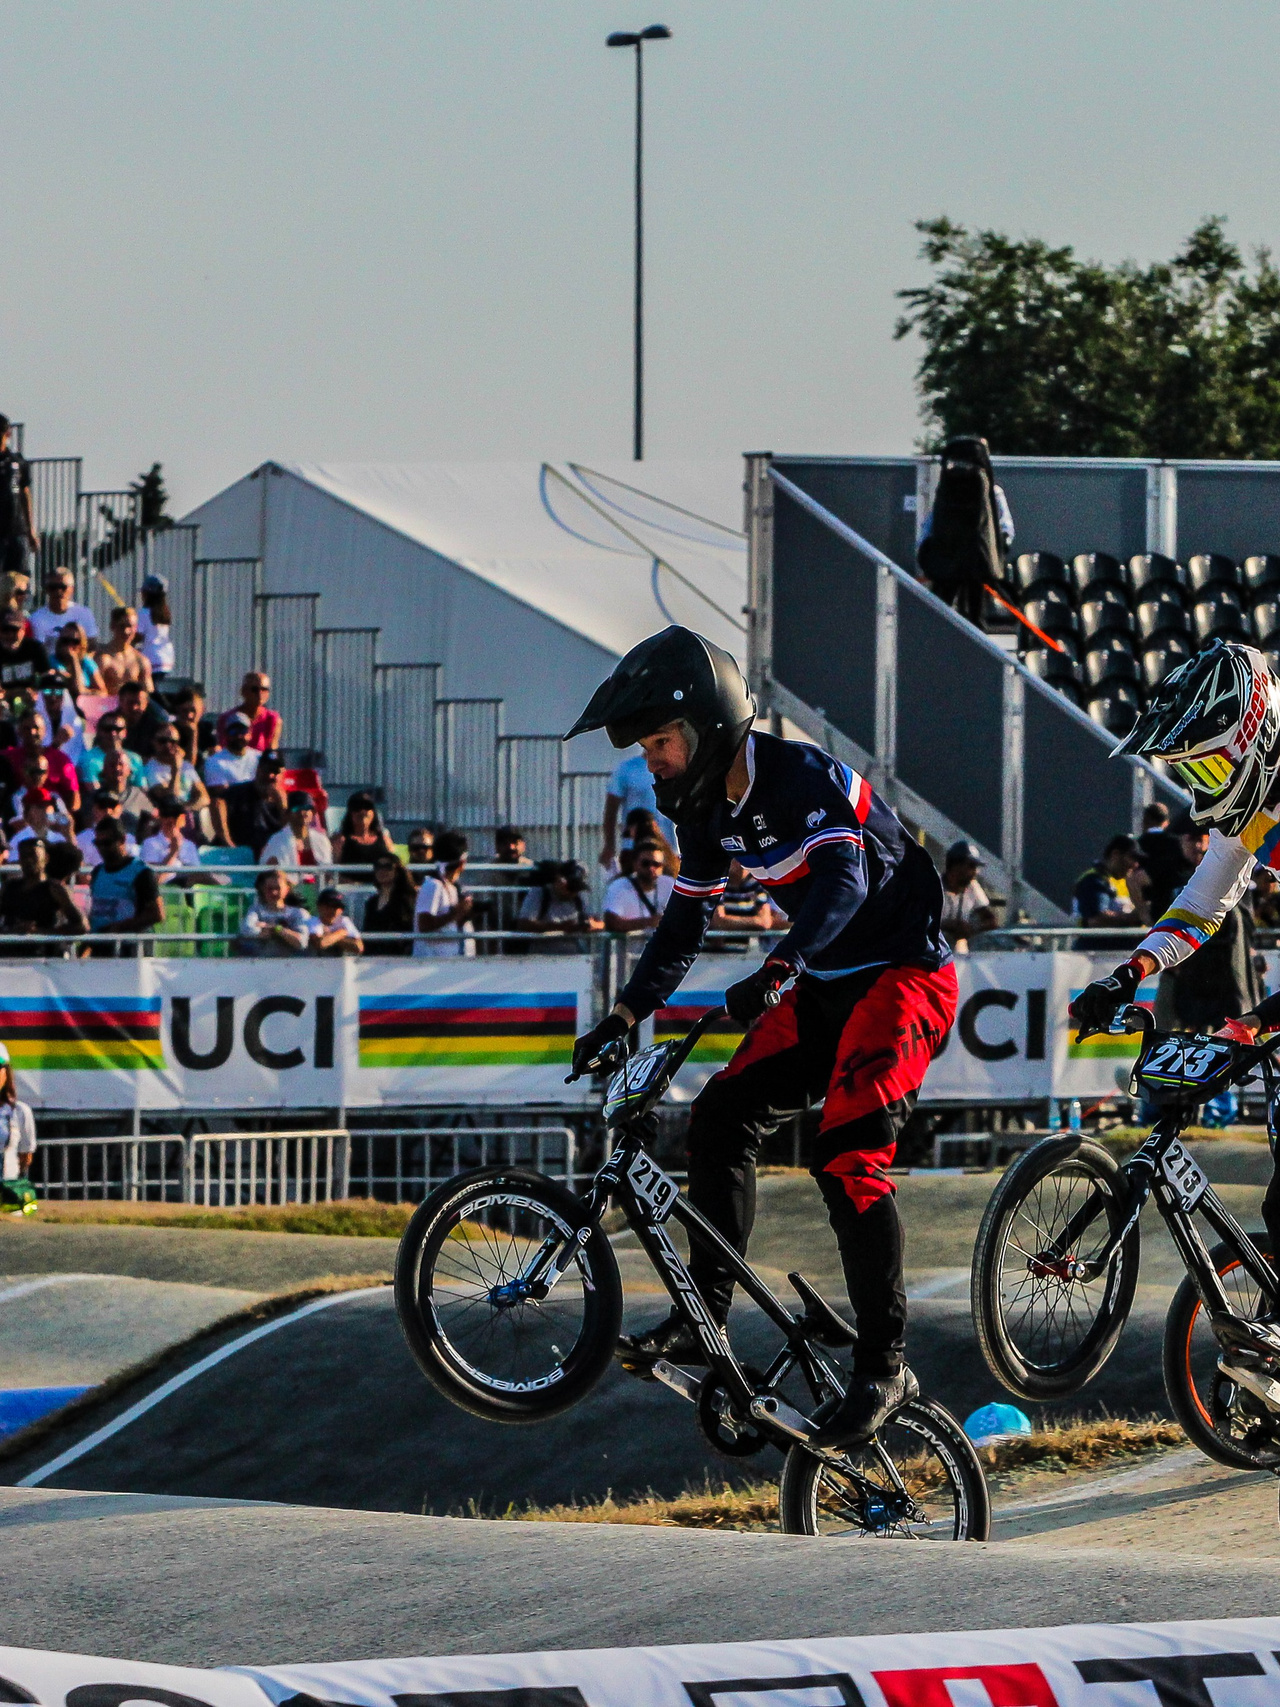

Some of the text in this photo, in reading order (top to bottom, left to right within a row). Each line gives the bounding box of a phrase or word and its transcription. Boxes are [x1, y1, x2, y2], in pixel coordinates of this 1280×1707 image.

[1233, 669, 1269, 755] 100%
[171, 995, 334, 1071] UCI
[930, 988, 1046, 1061] CI
[1142, 1044, 1216, 1078] 213
[632, 1159, 671, 1207] 219
[1165, 1144, 1202, 1193] 213
[638, 1205, 726, 1356] HASE
[895, 1415, 968, 1541] BOMBSHEL
